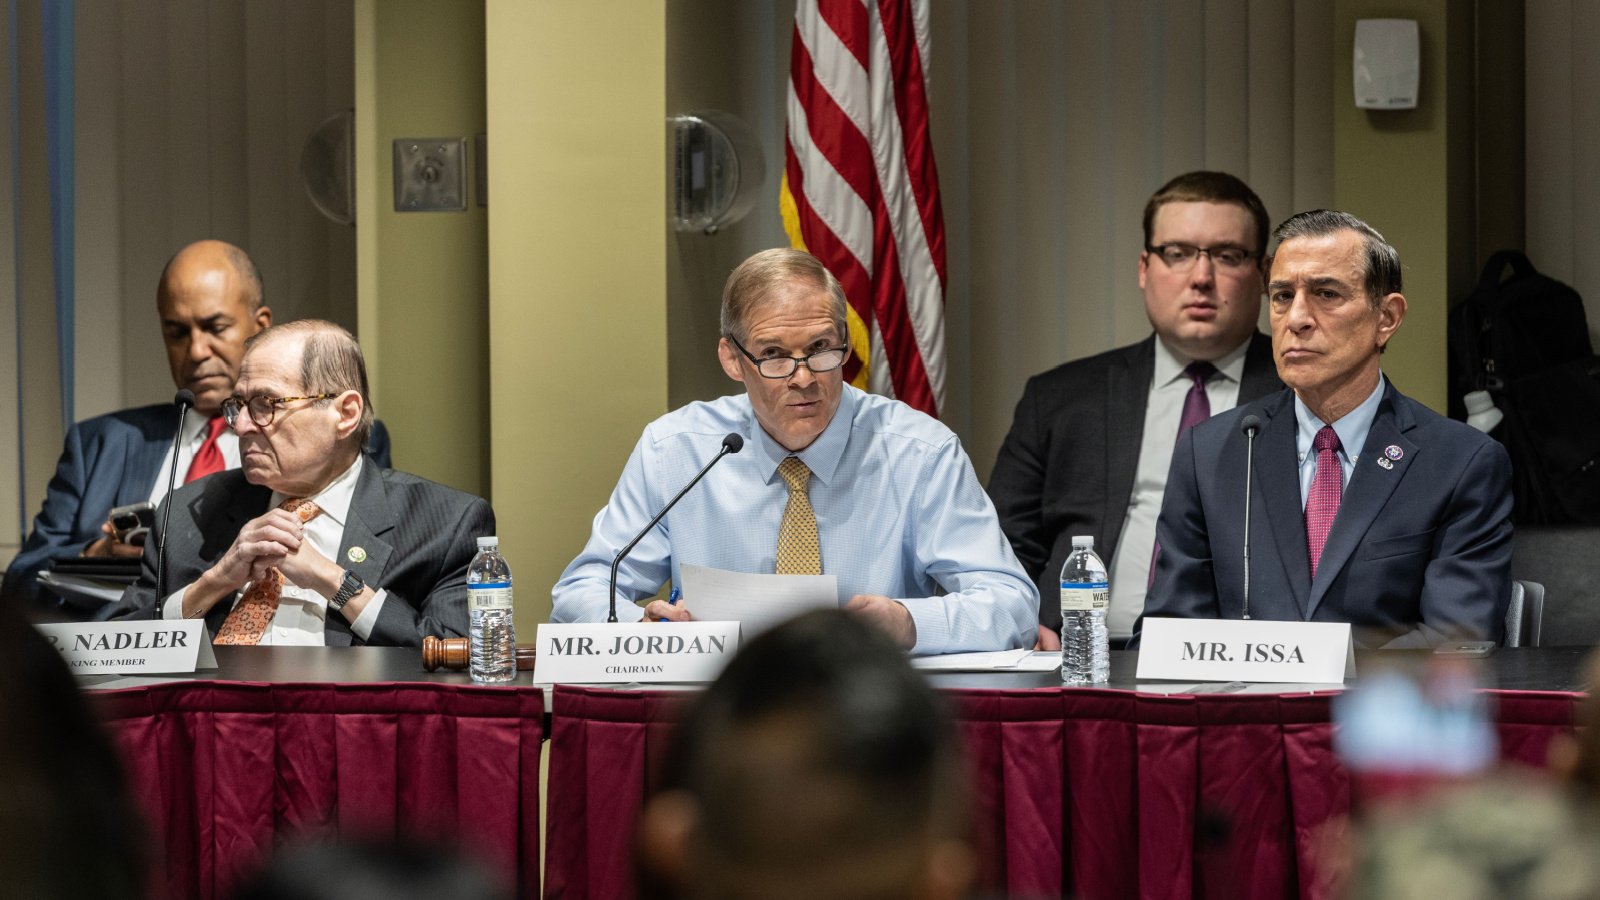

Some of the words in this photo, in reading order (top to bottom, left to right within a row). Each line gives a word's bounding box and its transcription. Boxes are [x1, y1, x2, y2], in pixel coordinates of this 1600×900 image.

[1092, 592, 1109, 601] WATE
[47, 635, 65, 651] R.
[72, 630, 188, 651] NADLER
[549, 637, 601, 656] MR.
[608, 635, 727, 655] JORDAN
[1181, 641, 1234, 662] MR.
[1244, 643, 1305, 664] ISSA
[70, 660, 98, 668] KING
[100, 658, 146, 667] MEMBER
[605, 665, 664, 674] CHAIRMAN
